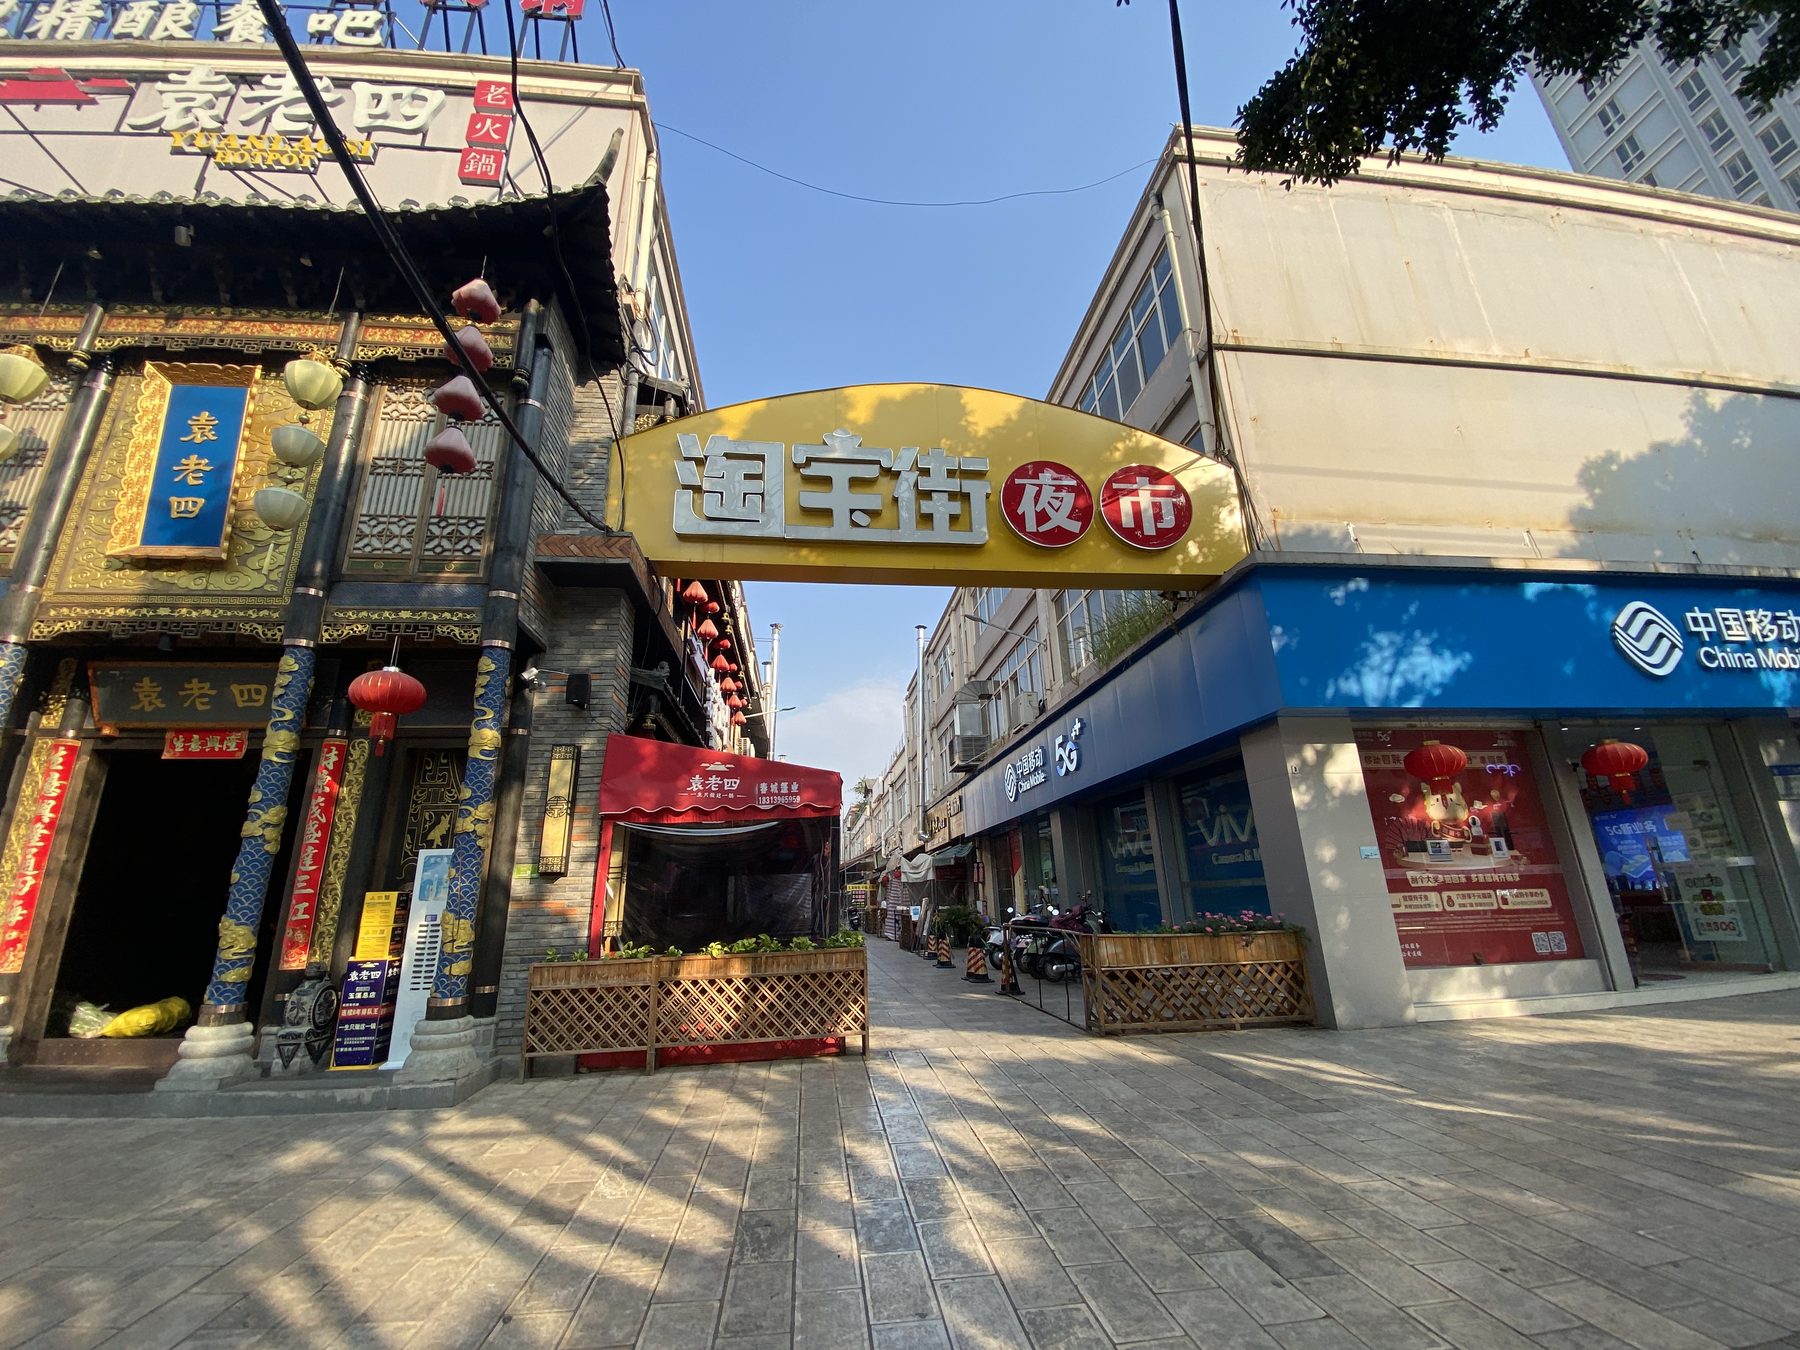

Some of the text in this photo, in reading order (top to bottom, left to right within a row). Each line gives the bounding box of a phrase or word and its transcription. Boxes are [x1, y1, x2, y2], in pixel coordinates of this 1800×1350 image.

[0, 0, 385, 46] 精酿餐吧
[127, 65, 446, 136] 袁老四
[213, 150, 318, 168] HOTPOT
[169, 411, 219, 519] 袁老四
[673, 427, 1179, 546] 淘宝街 夜市
[1684, 606, 1800, 643] 中国移动
[1699, 646, 1758, 669] China
[130, 676, 268, 712] 袁老四
[1016, 746, 1043, 778] 中国移动
[686, 774, 741, 791] 袁老四
[1018, 770, 1046, 793] China Mobile
[348, 970, 381, 981] 袁老四
